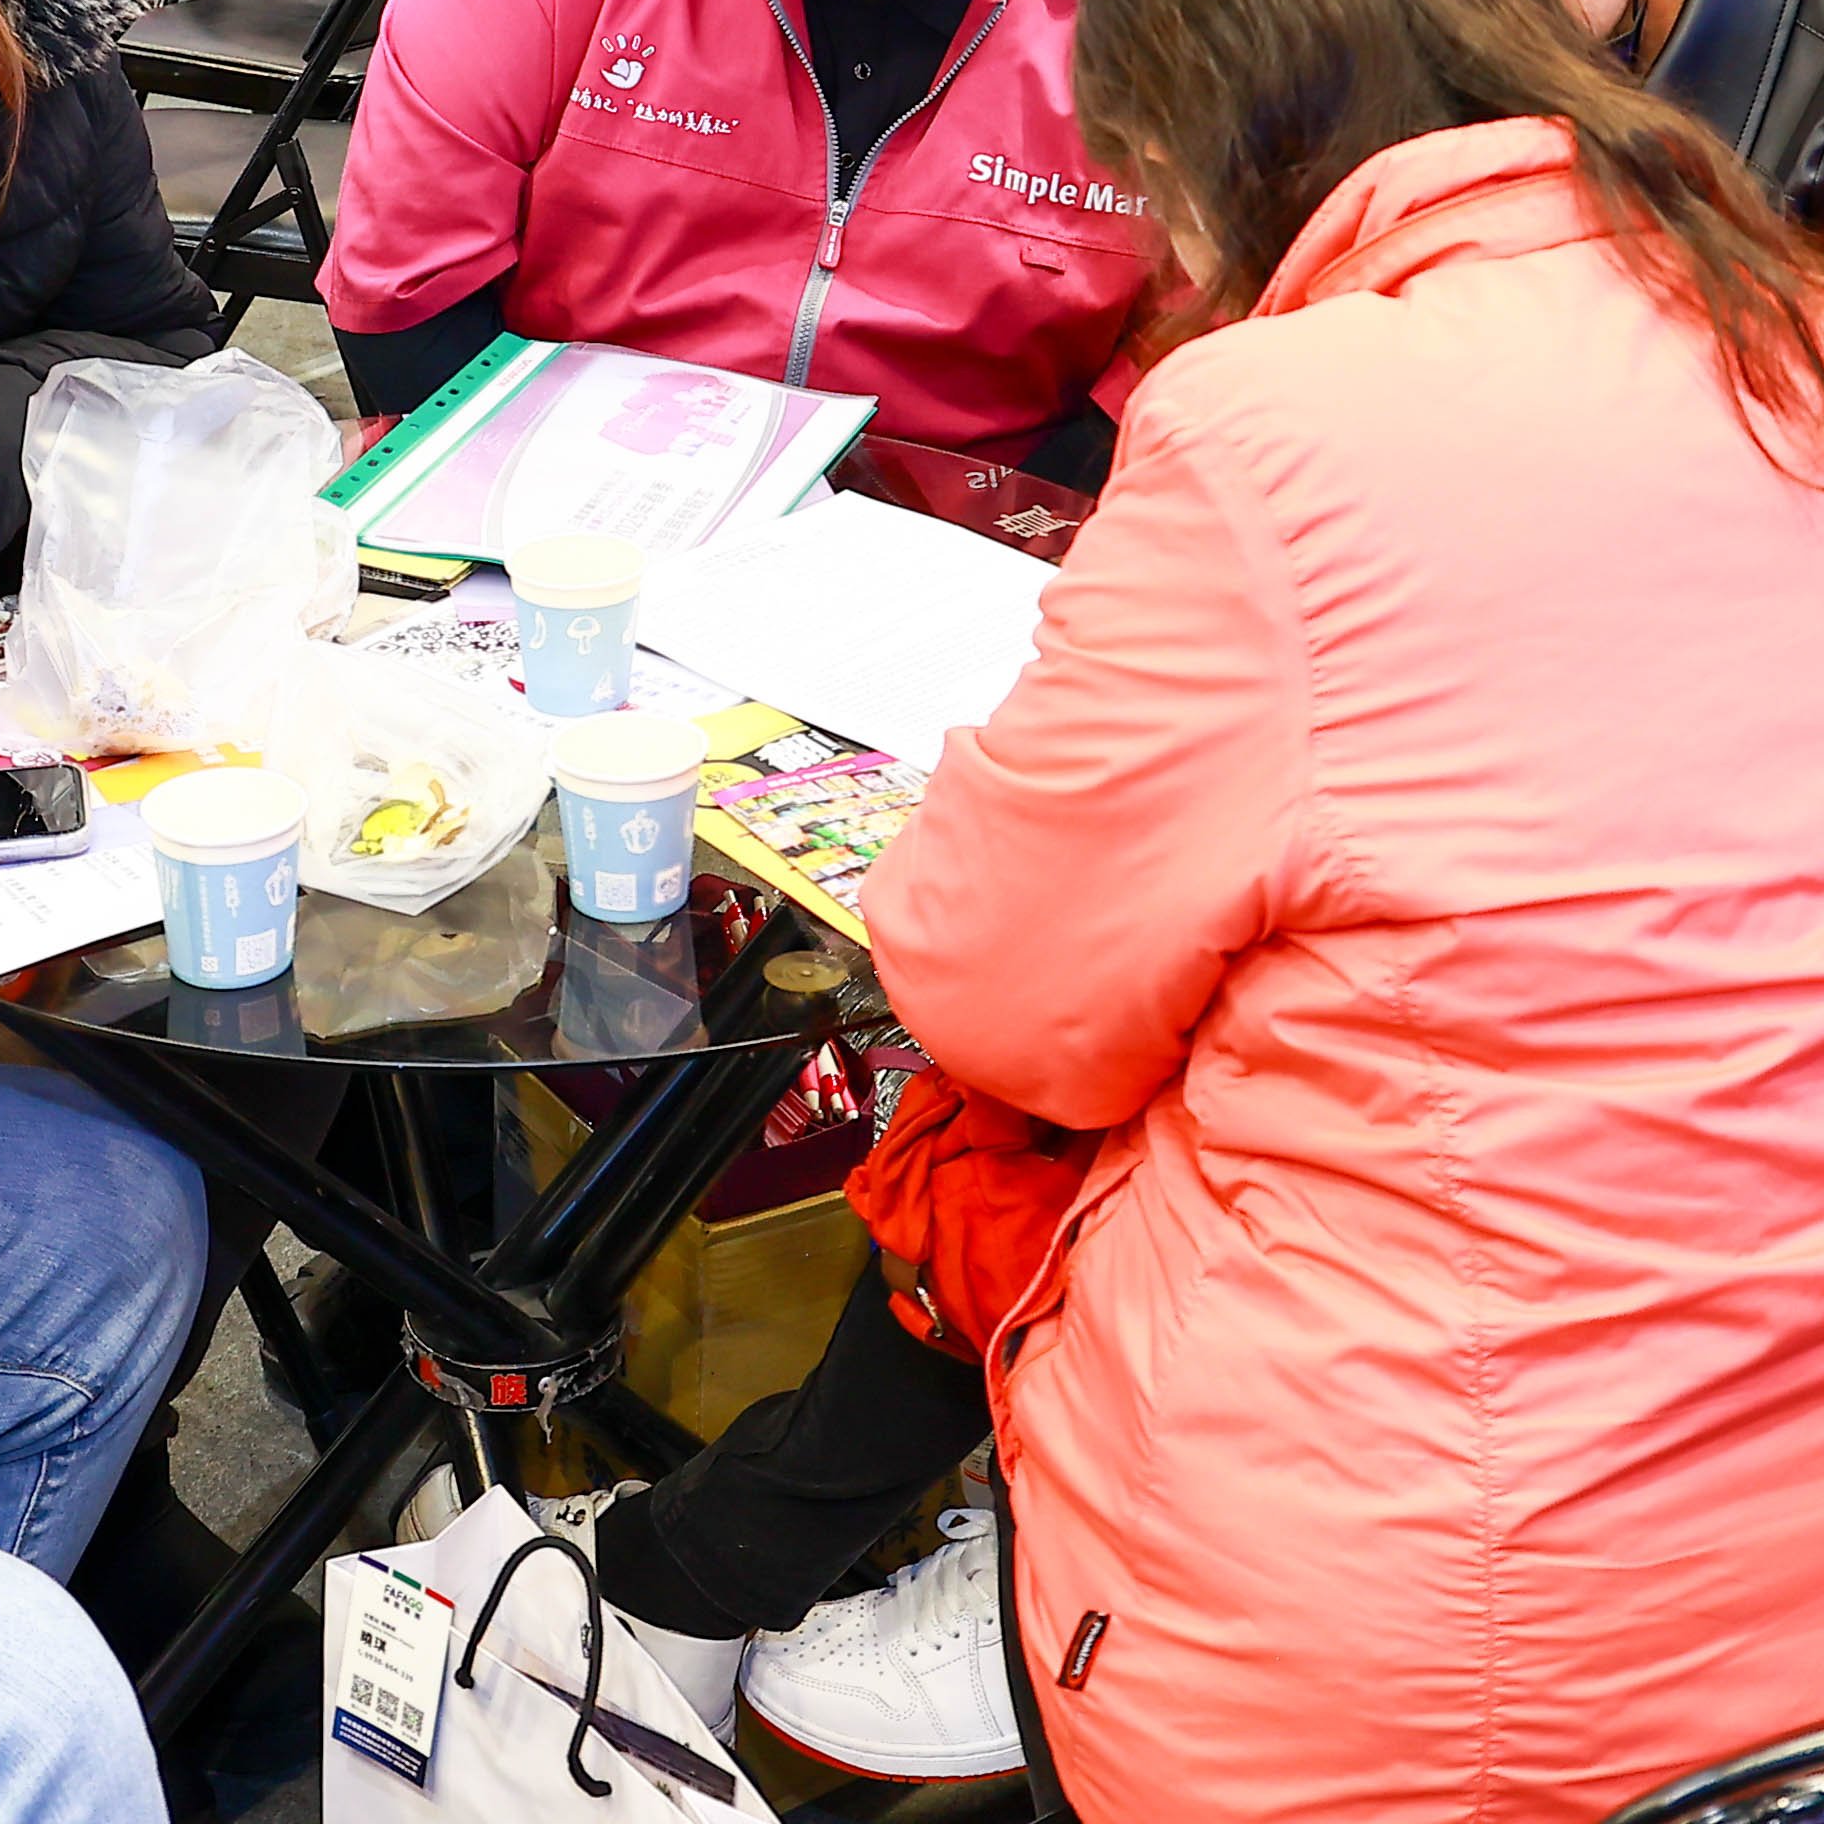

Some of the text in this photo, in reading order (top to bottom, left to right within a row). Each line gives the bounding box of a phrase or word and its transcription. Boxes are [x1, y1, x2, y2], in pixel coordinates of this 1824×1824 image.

[967, 152, 1079, 208] Simple
[490, 1372, 529, 1407] 族
[383, 1583, 425, 1613] FAFAGO
